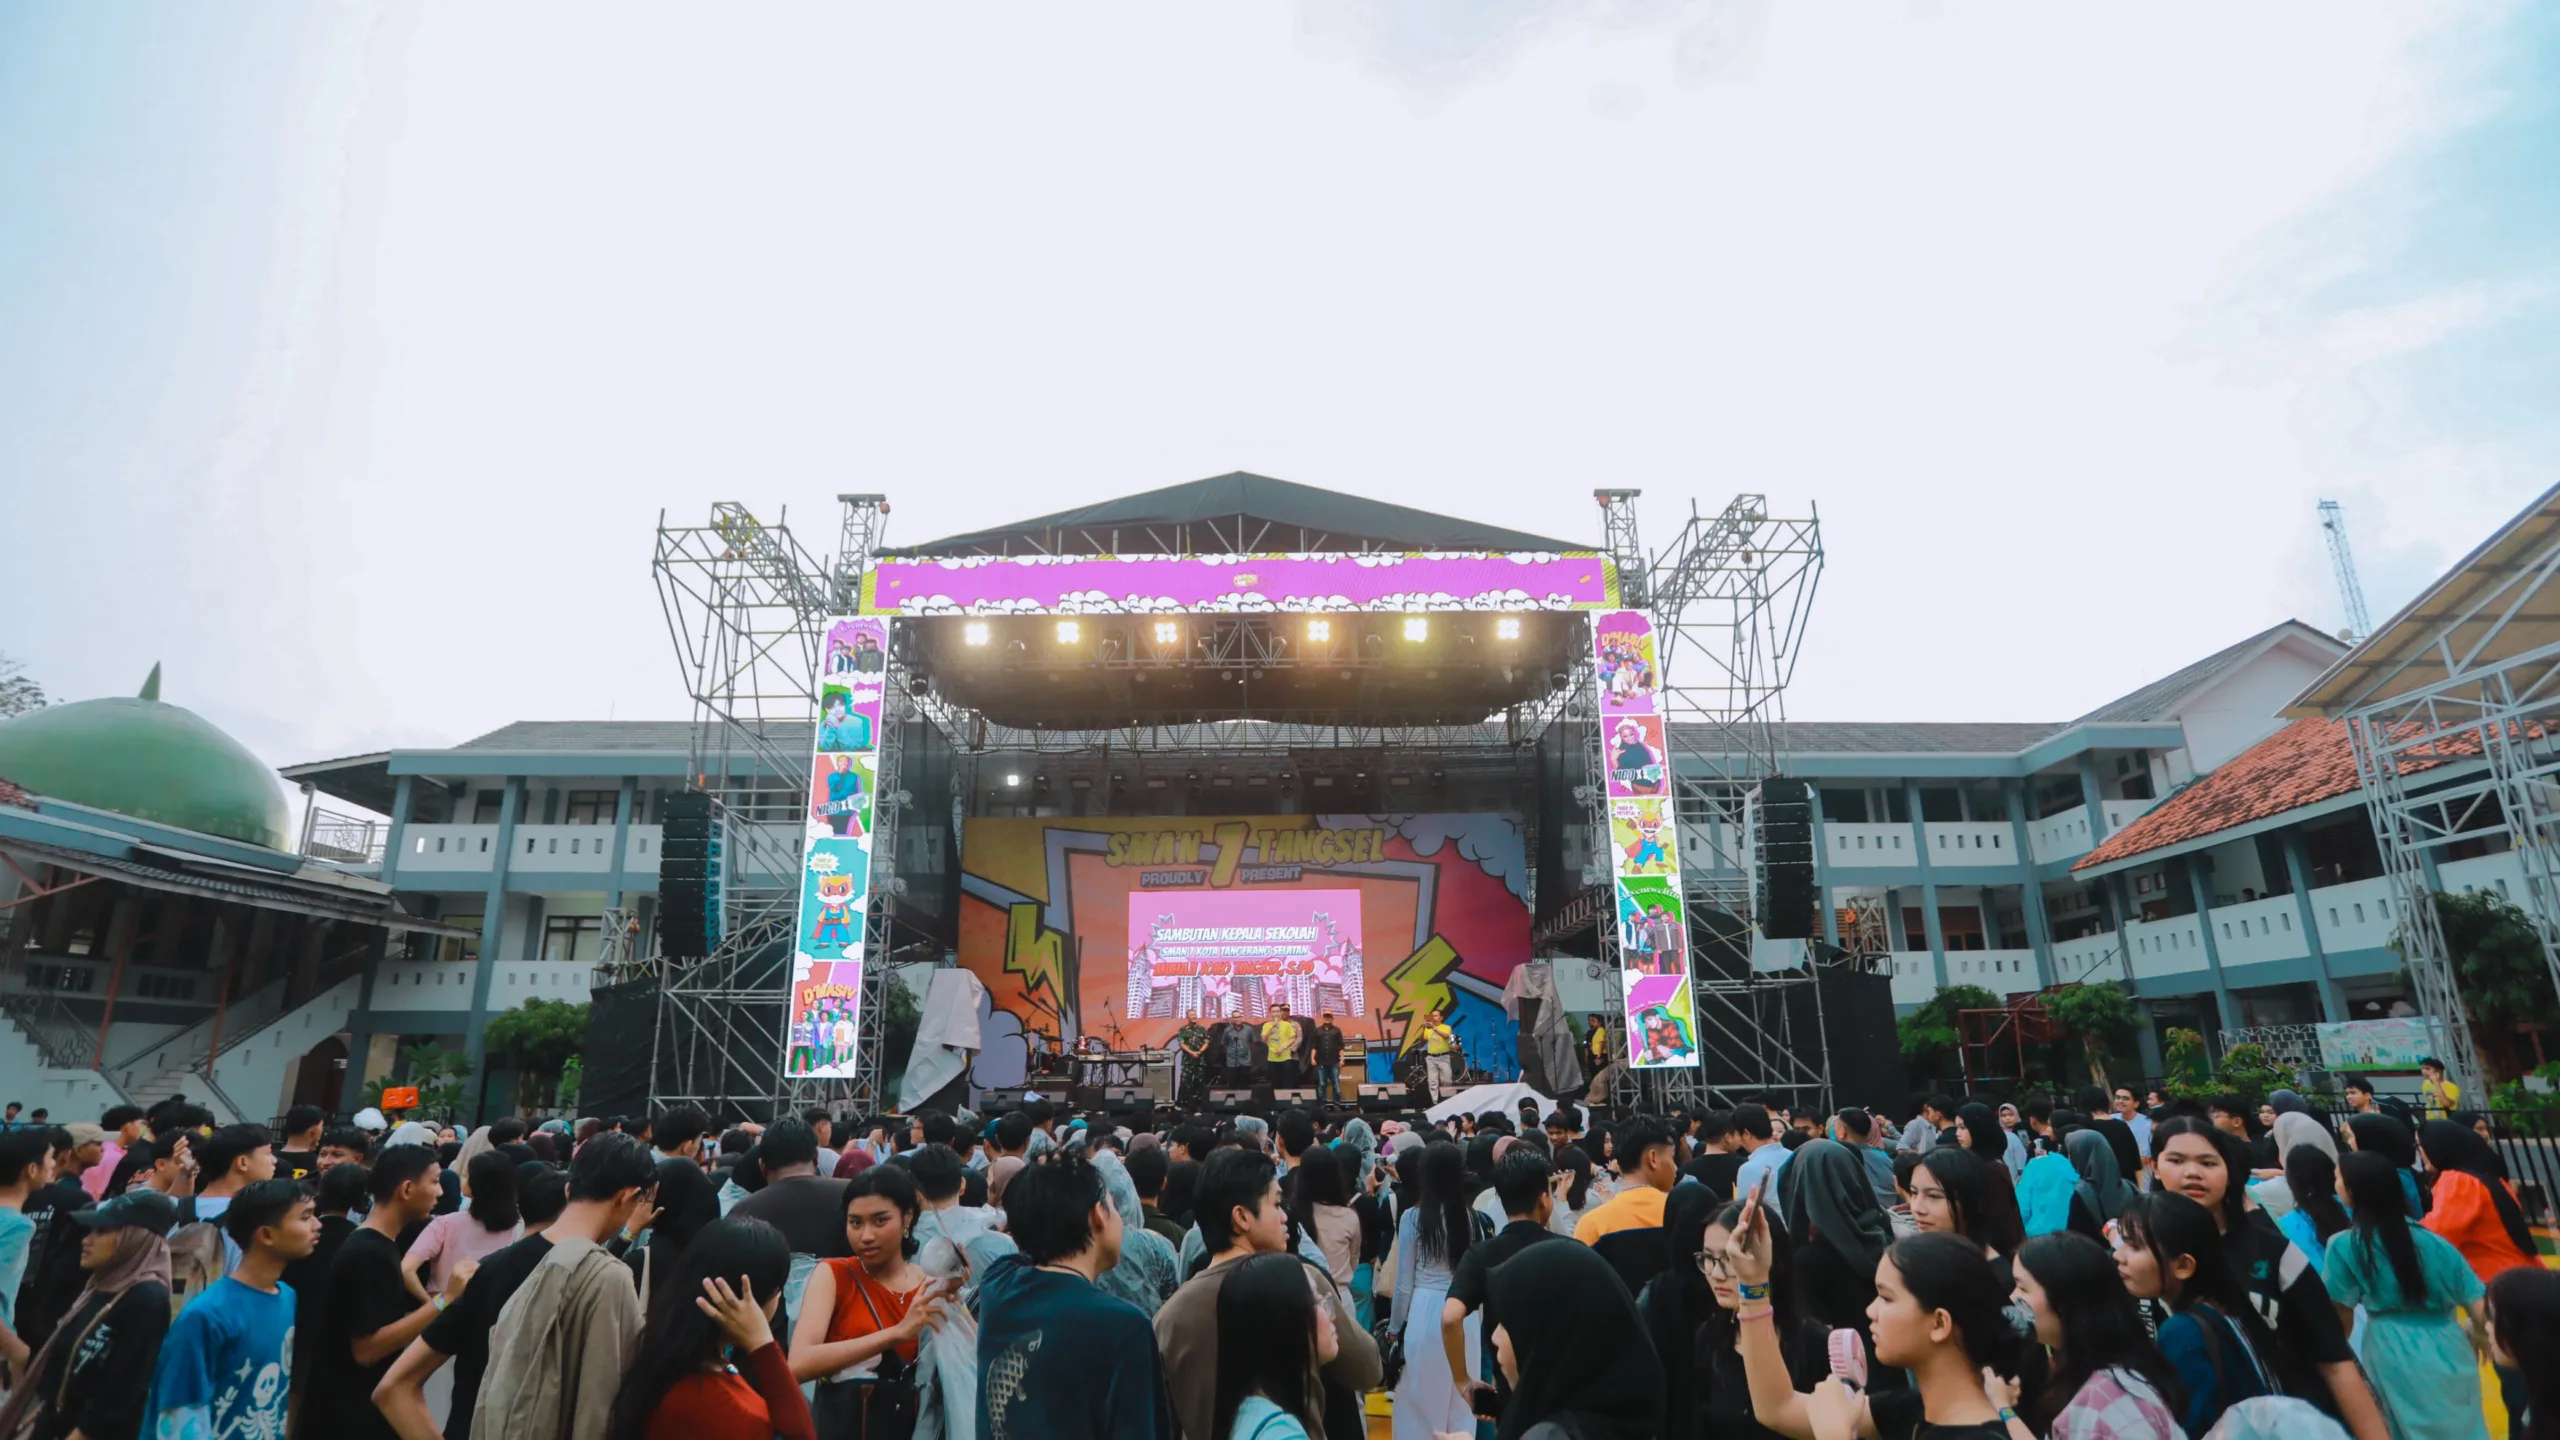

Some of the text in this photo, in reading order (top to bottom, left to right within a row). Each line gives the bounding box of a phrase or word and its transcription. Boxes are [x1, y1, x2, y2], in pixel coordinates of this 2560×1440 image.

[1104, 821, 1386, 889] SMAN 7 TANGSEL
[1141, 866, 1303, 887] PROUDLY PRESENT
[1156, 926, 1318, 942] SAMBUTAN KEPALA SEKOLAH
[1162, 945, 1309, 957] SMAN 7 KOTA TANGERANG SELATAN
[1200, 960, 1232, 976] JOKO
